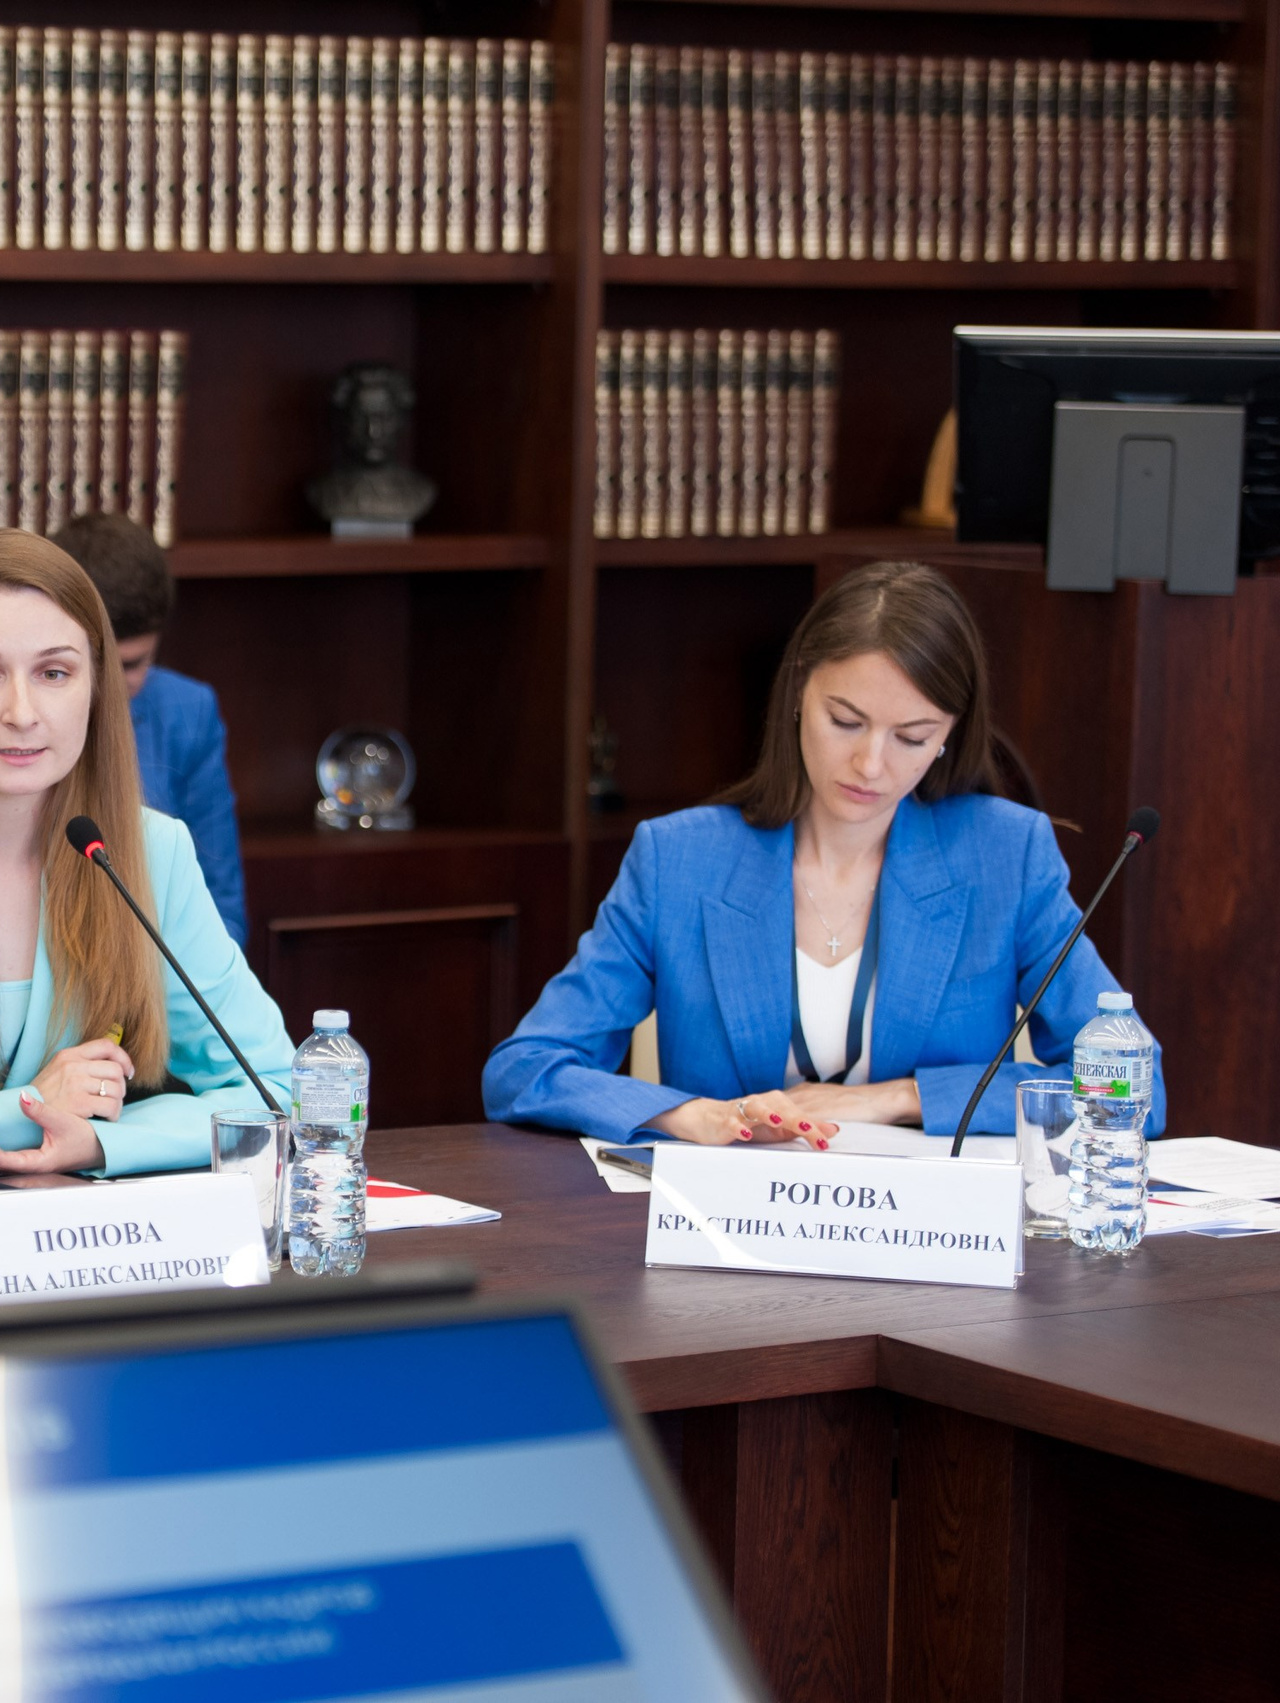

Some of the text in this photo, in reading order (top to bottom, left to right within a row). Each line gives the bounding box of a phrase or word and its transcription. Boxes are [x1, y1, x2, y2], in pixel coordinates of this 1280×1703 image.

[1074, 1062, 1127, 1079] ЕНЕЖСКАЯ
[769, 1181, 899, 1211] РОГОВА
[33, 1221, 163, 1253] ПОПОВА
[793, 1223, 1007, 1253] АЛЕКСАНДРОВНА
[44, 1255, 231, 1291] АЛЕКСАНДРОВН
